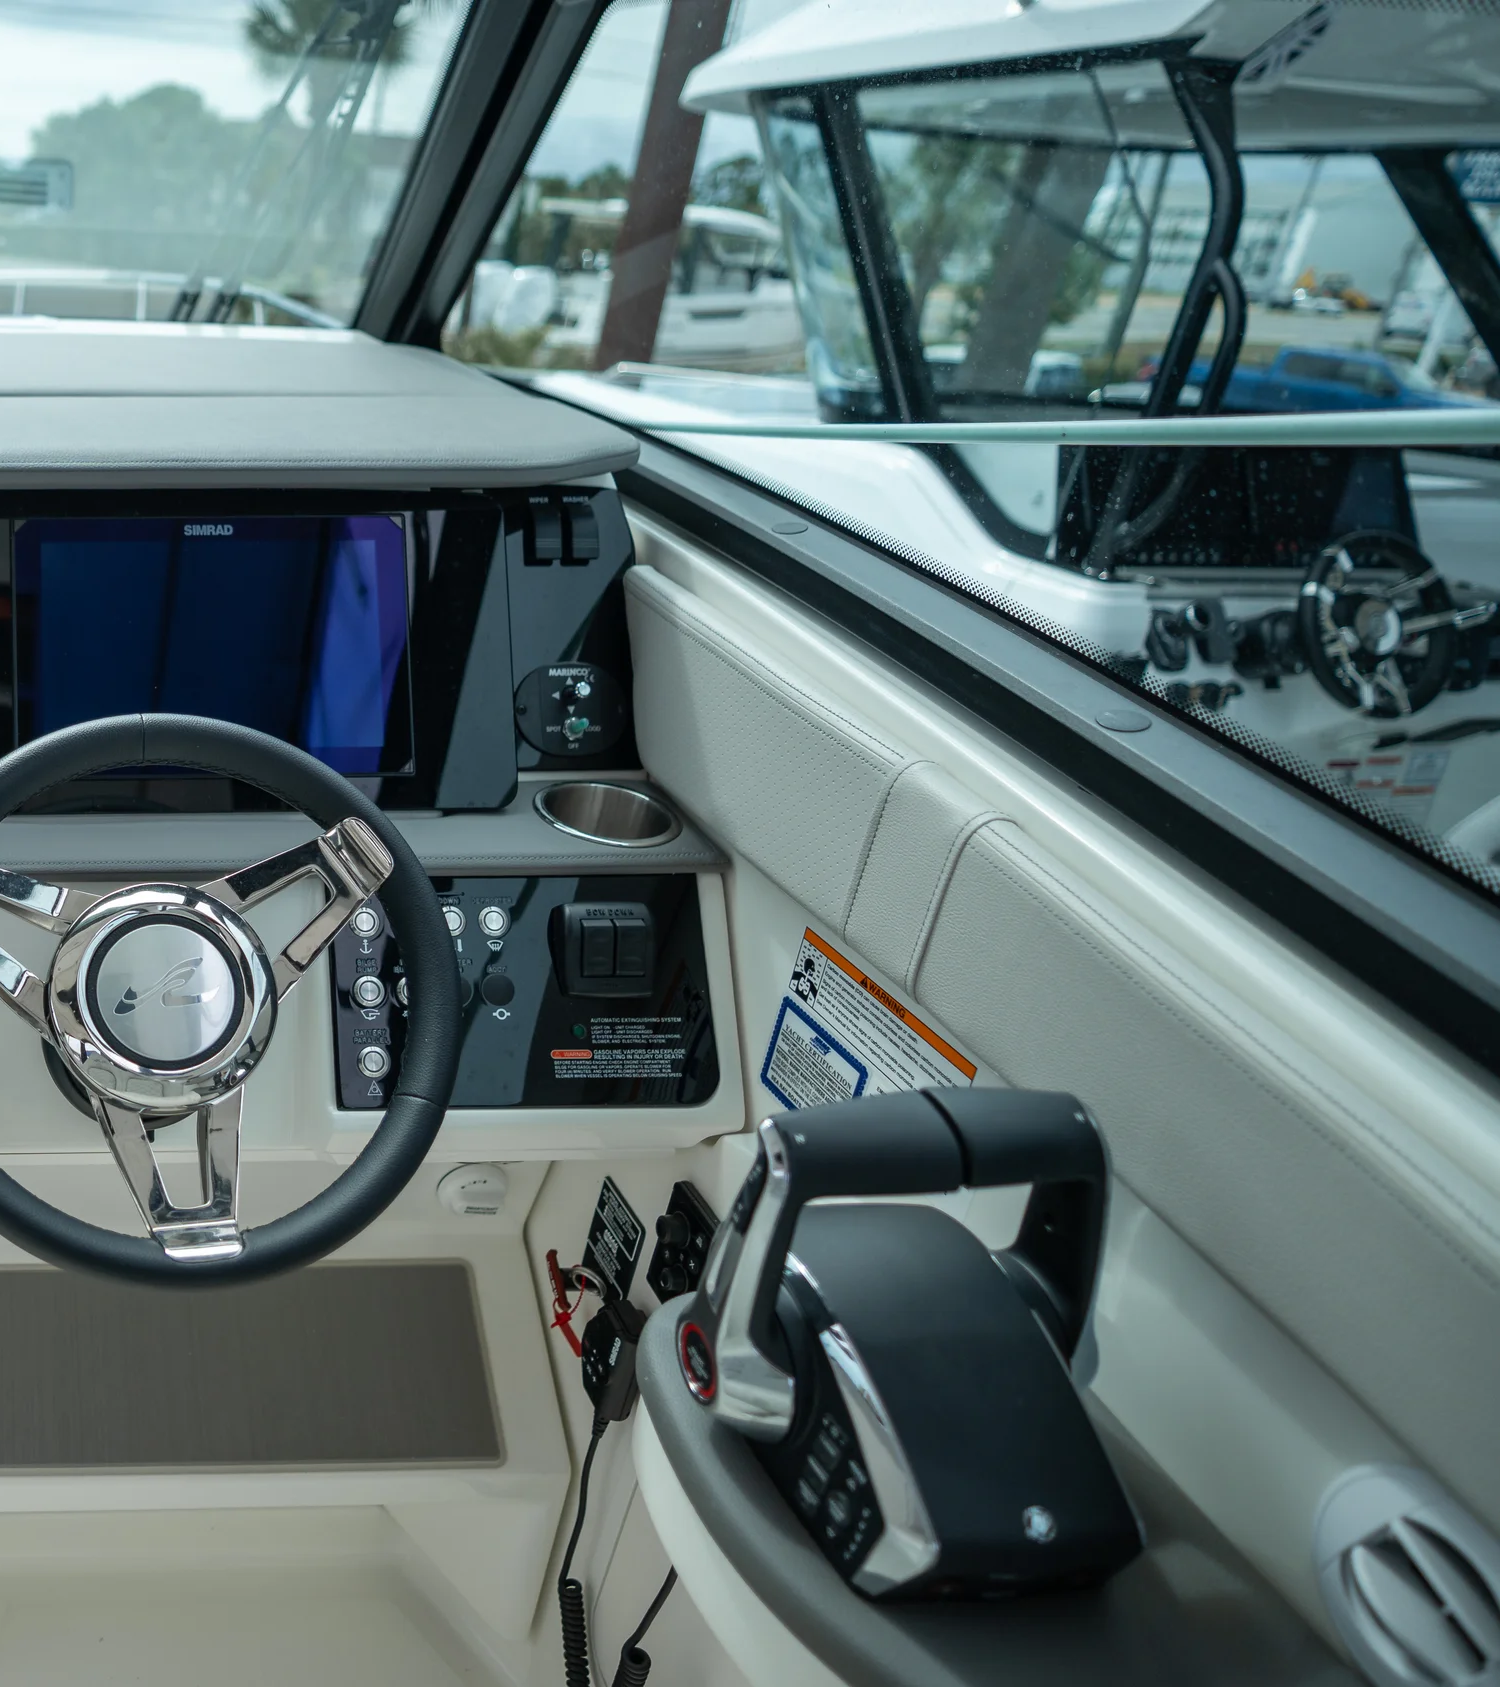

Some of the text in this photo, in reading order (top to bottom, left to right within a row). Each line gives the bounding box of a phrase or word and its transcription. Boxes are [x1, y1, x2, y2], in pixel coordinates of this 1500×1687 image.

[184, 524, 233, 536] SIMRAD
[549, 668, 588, 676] MARINCO
[869, 981, 905, 1019] WARNING
[786, 1024, 804, 1042] YACHT
[805, 1043, 852, 1090] CERTIFICATION
